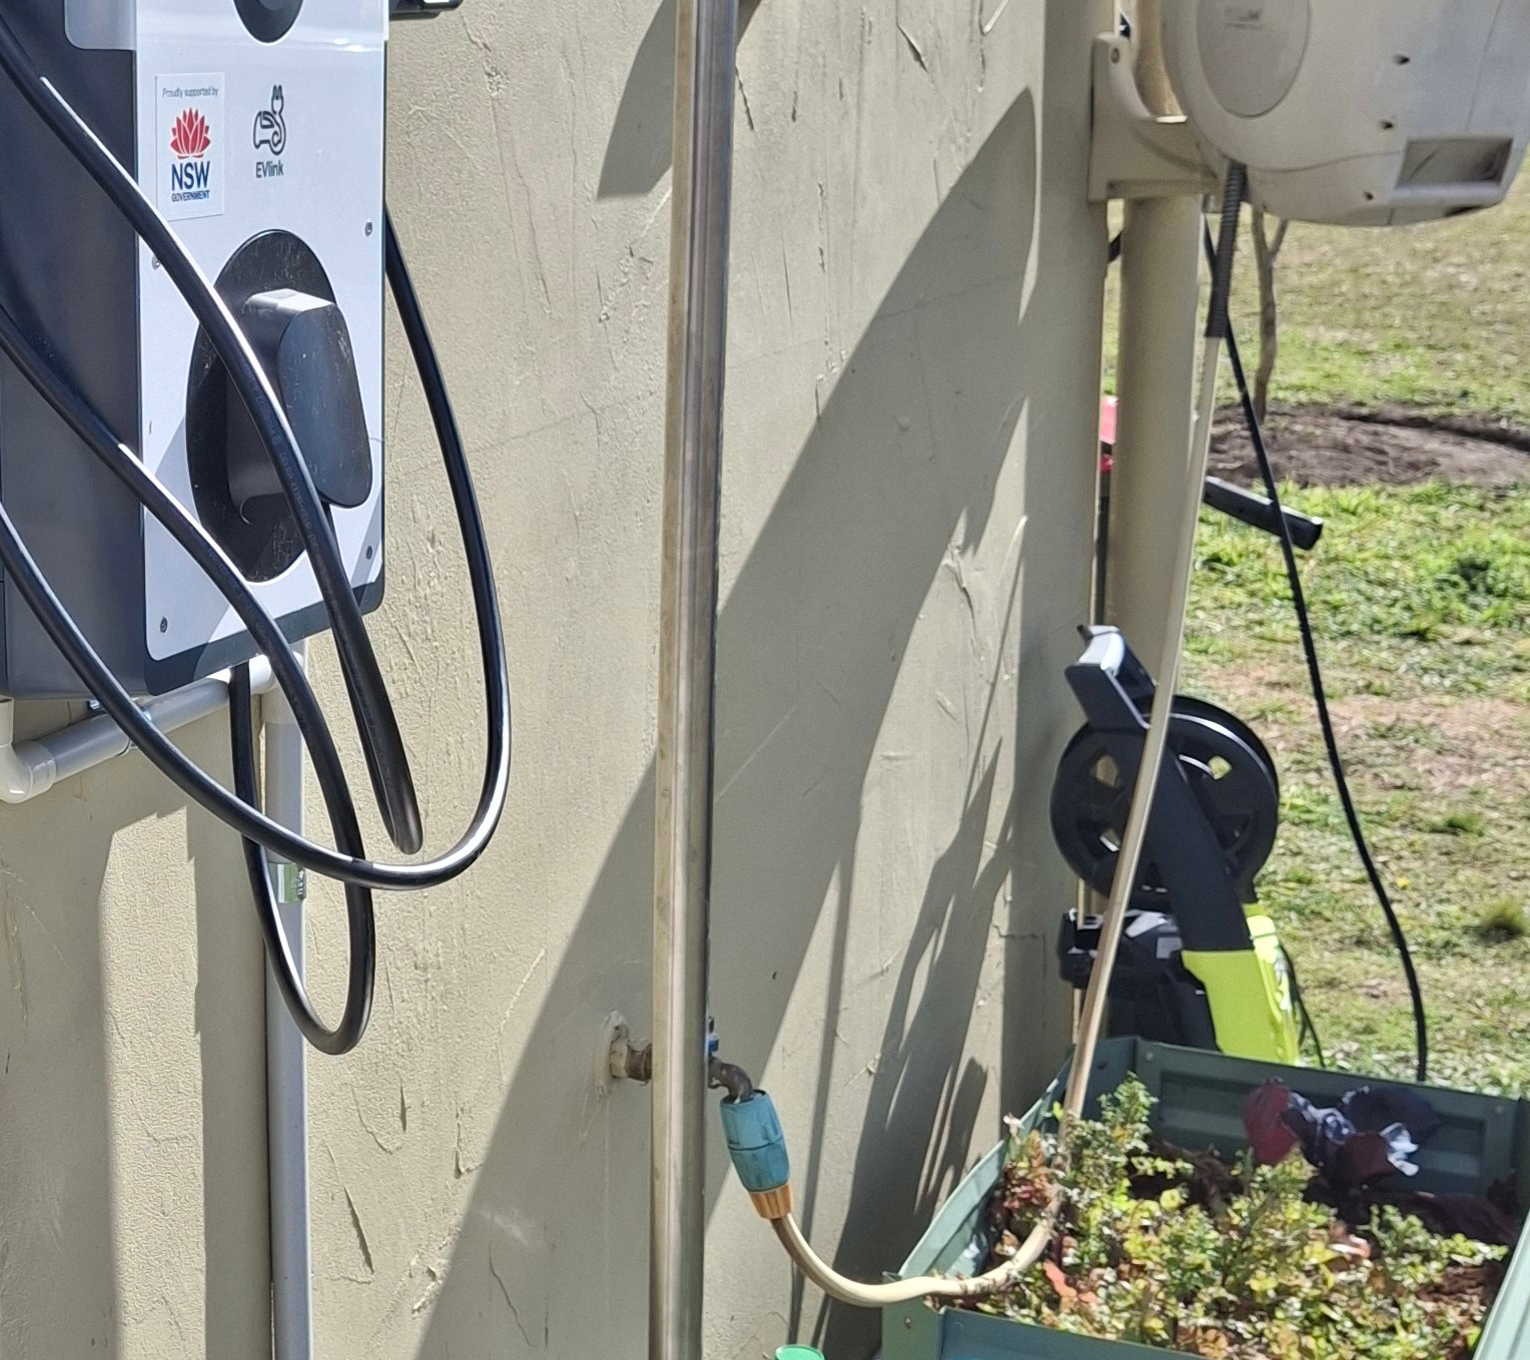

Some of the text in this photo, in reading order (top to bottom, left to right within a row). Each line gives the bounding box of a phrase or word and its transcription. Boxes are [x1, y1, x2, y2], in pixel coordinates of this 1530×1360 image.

[162, 86, 219, 98] Proudly supported by
[171, 161, 211, 190] NSW
[255, 160, 284, 179] EVlink
[171, 190, 210, 203] GOVERNMENT
